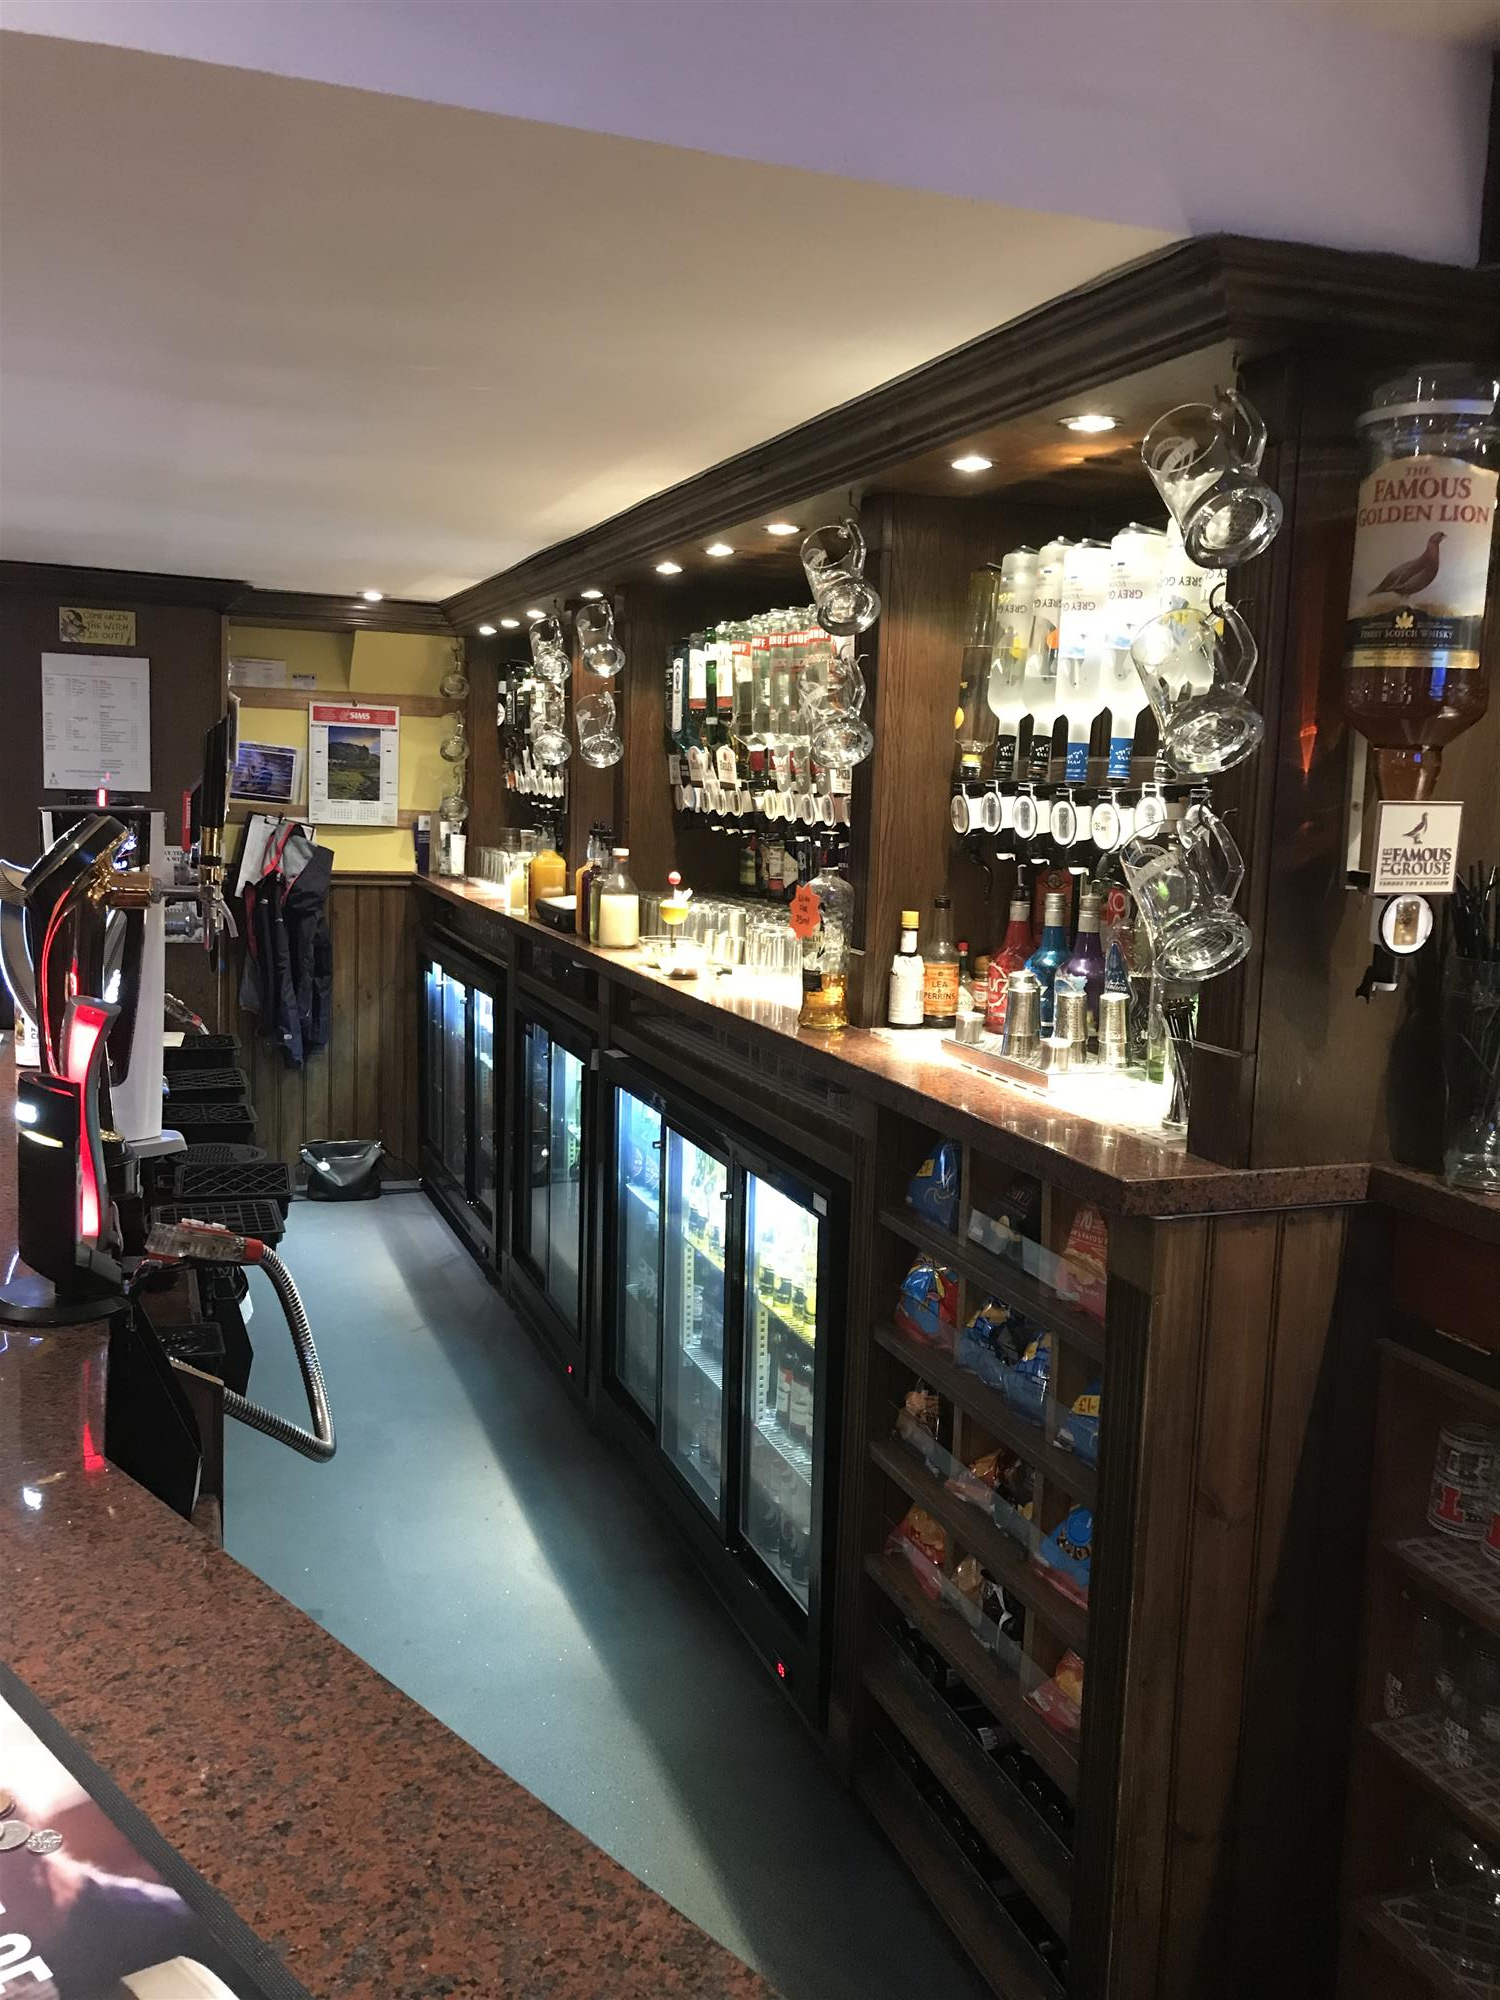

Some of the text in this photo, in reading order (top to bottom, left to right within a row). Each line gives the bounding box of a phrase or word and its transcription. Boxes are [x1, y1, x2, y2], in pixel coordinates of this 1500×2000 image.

[1405, 466, 1432, 476] THE
[1373, 477, 1472, 503] FAMOUS
[1357, 504, 1490, 527] GOLDEN LION
[1384, 628, 1418, 638] SCOTCH
[1421, 629, 1453, 639] WHISKY
[349, 711, 371, 720] SIMS
[1380, 847, 1452, 875] THE FAMOUS
[1391, 861, 1450, 876] GROUSE
[924, 991, 955, 1000] PERRINS
